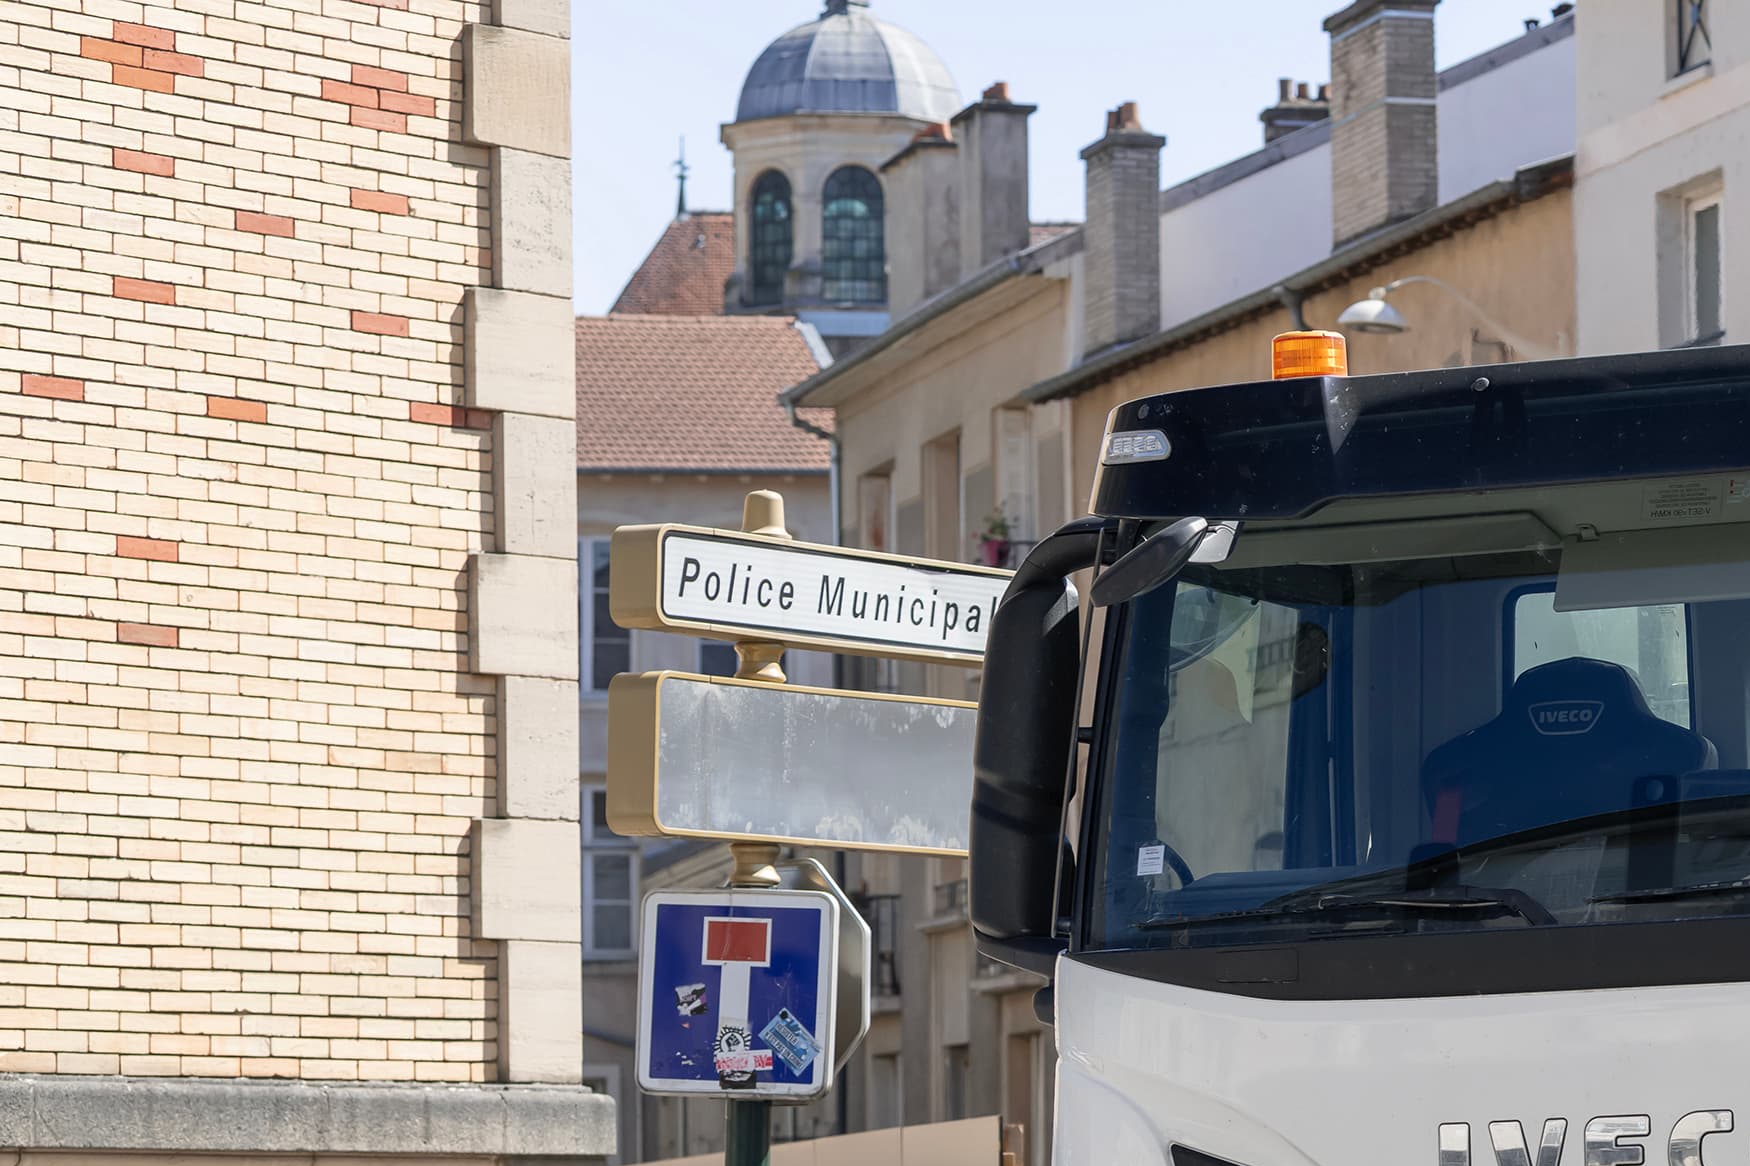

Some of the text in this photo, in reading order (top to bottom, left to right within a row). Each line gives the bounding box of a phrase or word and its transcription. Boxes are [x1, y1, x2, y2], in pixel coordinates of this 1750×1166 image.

[678, 556, 998, 641] Police Municipal
[1538, 709, 1594, 725] IVECO
